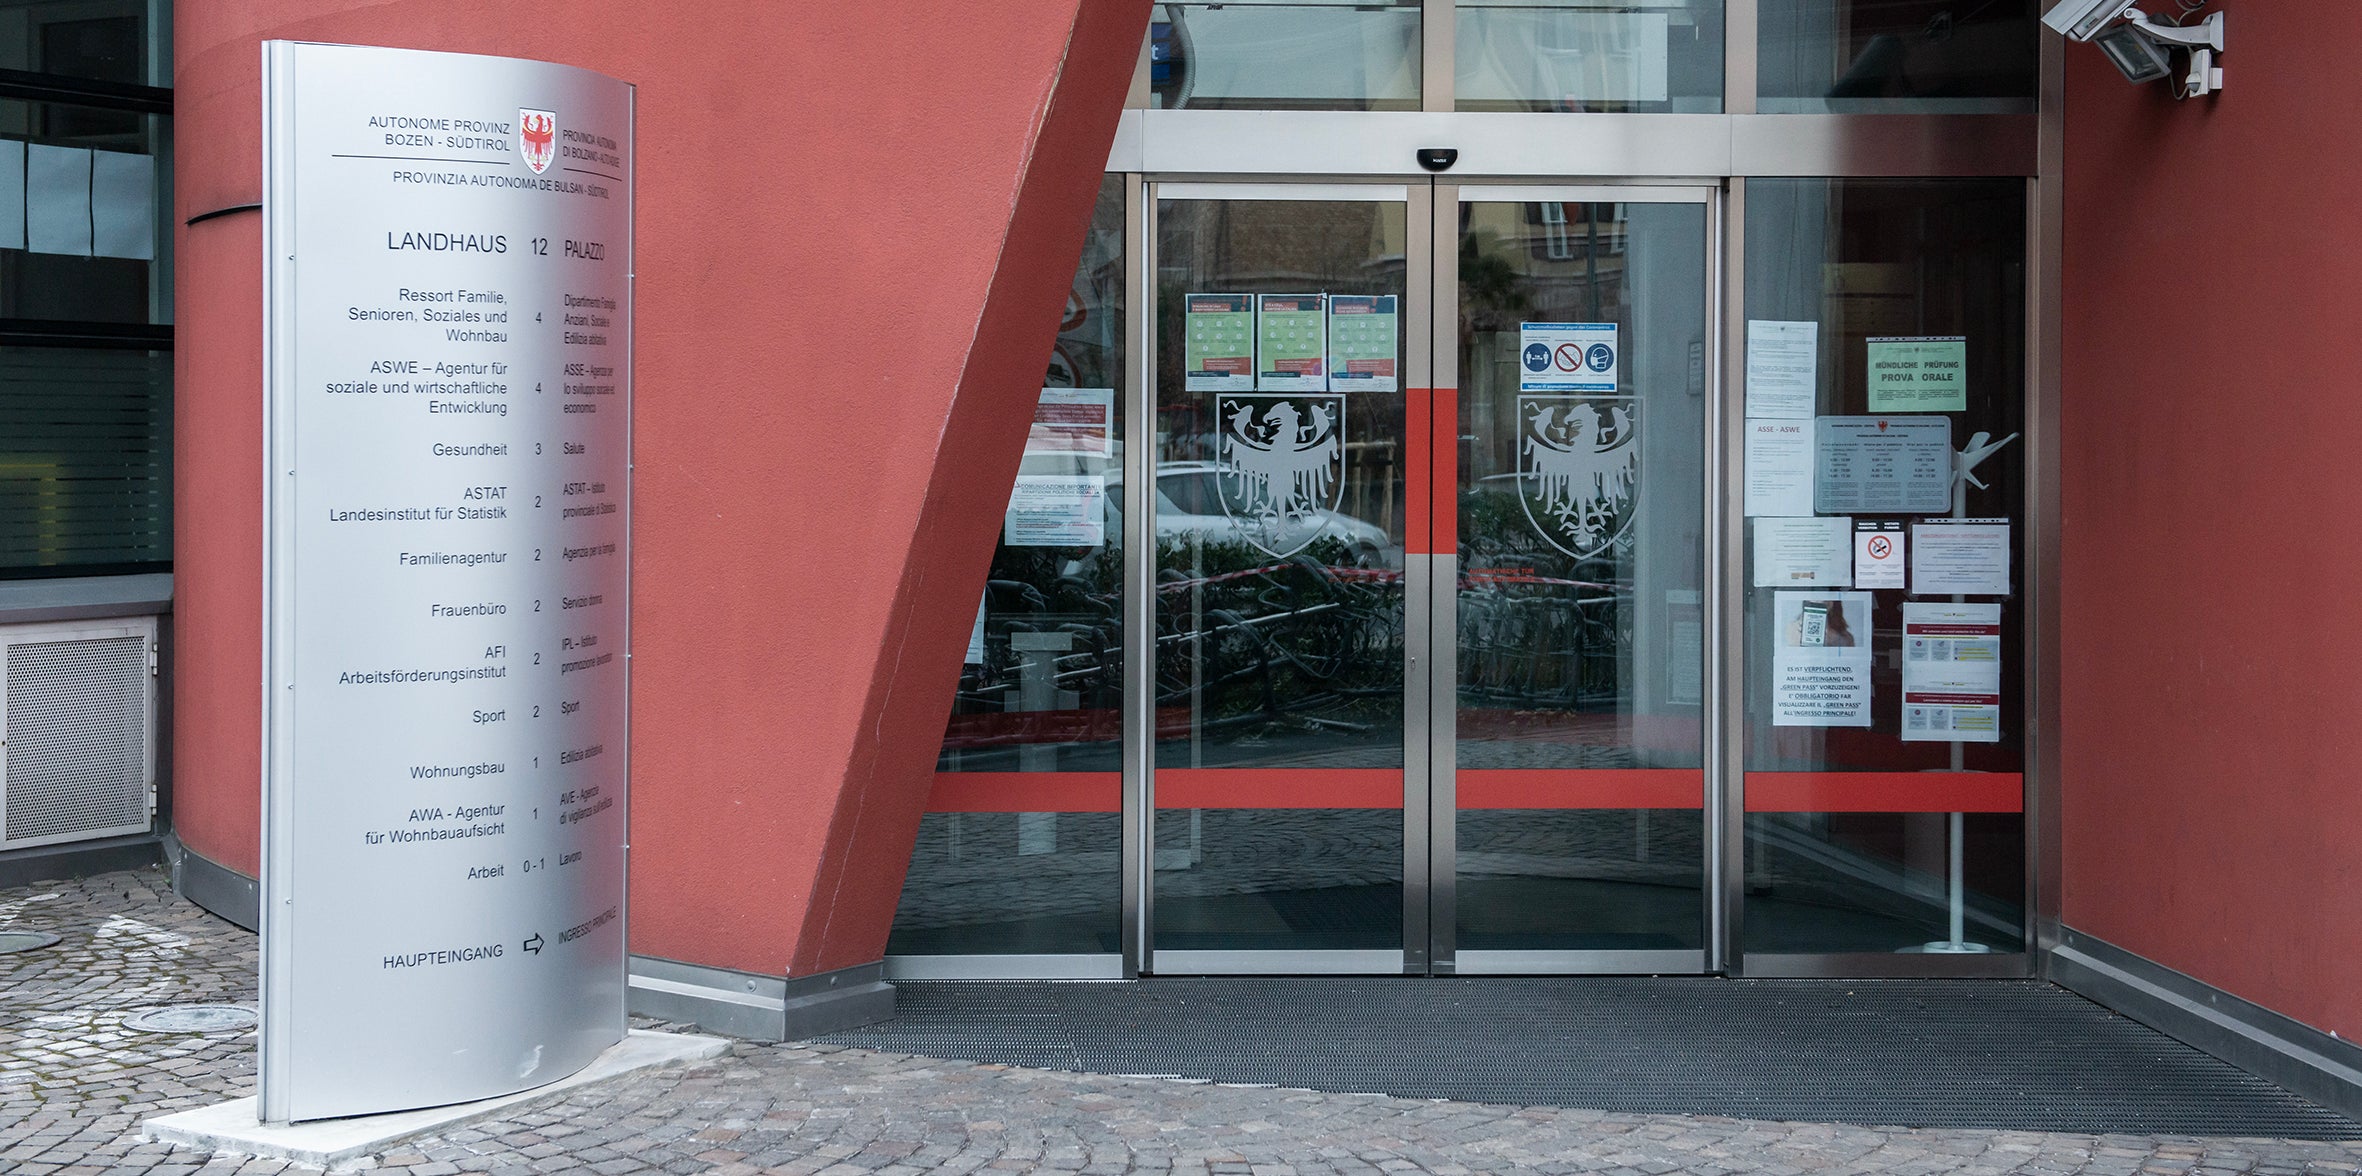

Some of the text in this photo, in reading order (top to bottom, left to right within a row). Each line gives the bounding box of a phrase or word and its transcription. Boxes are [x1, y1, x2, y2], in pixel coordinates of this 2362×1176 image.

[368, 116, 510, 134] AUTONOME PROVINZ
[385, 133, 434, 147] BOZEN
[446, 135, 511, 152] SÜDTIROL
[563, 146, 570, 157] DI
[393, 171, 468, 186] PROVINZIA
[470, 174, 538, 190] AUTONOMA
[540, 179, 552, 192] DE
[554, 180, 584, 194] BULSAN
[388, 231, 508, 254] LANDHAUS
[531, 238, 548, 256] 12
[565, 240, 605, 260] PALAZZO
[399, 288, 508, 306] Ressort Familie,
[348, 307, 508, 324] Senioren, Soziales und
[535, 312, 542, 324] 4
[446, 328, 508, 343] Wohnbau
[370, 360, 418, 375] ASWE
[435, 361, 488, 378] Agentur
[491, 362, 508, 376] für
[564, 364, 584, 376] ASSE
[1876, 360, 1959, 369] MÜNDLICHE PRÜFUNG
[1881, 373, 1953, 382] PROVA ORALE
[326, 380, 508, 395] soziale und wirtschaftliche
[535, 382, 542, 394] 4
[429, 400, 508, 417] Entwicklung
[432, 442, 508, 456] Gesundheit
[535, 442, 542, 455] 3
[564, 442, 585, 455] Salute
[464, 486, 508, 500] ASTAT
[562, 482, 586, 496] ASTAT
[534, 496, 542, 508] 2
[330, 506, 507, 522] Landesinstitut für Statistik
[399, 552, 507, 568] Familienagentur
[534, 549, 541, 562] 2
[432, 602, 507, 618] Frauenbüro
[534, 600, 540, 612] 2
[562, 637, 574, 650] IPL
[484, 646, 506, 660] AFI
[534, 652, 540, 665] 2
[338, 666, 506, 685] Arbeitsförderungsinstitut
[533, 706, 540, 718] 2
[561, 701, 580, 716] Sport
[472, 708, 506, 726] Sport
[410, 762, 505, 780] Wohnungsbau
[532, 757, 538, 770] 1
[560, 790, 576, 806] AVE
[409, 808, 444, 822] AWA
[455, 804, 505, 821] Agentur
[532, 808, 538, 820] 1
[560, 812, 566, 825] di
[365, 822, 505, 846] für Wohnbauaufsicht
[523, 860, 530, 873] 0
[540, 858, 545, 870] 1
[560, 850, 582, 866] Lavoro
[467, 864, 504, 880] Arbeit
[558, 918, 592, 945] INGRESSO
[383, 944, 504, 970] HAUPTEINGANG
